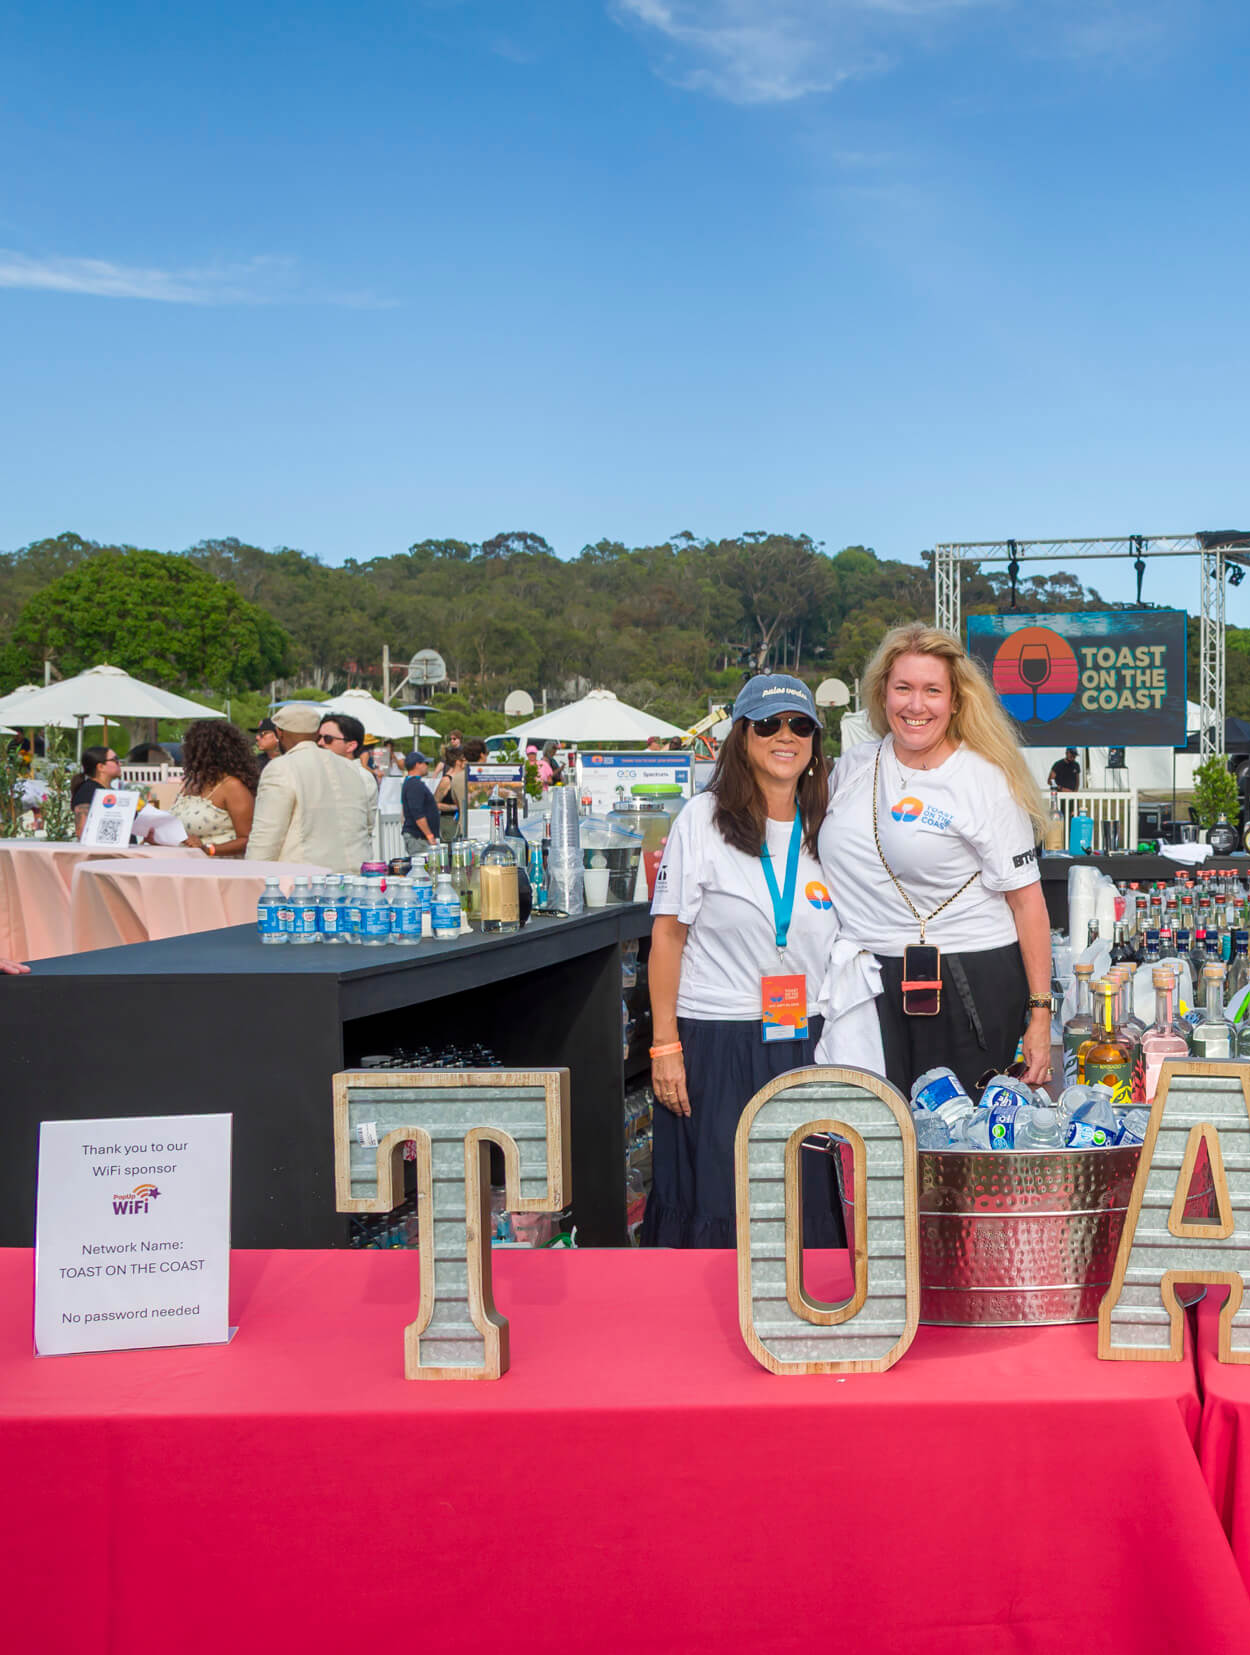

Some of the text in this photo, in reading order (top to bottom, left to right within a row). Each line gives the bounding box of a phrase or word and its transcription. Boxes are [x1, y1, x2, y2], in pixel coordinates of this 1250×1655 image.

[1080, 645, 1167, 668] TOAST
[1081, 668, 1166, 689] ON THE
[1081, 689, 1167, 710] COAST
[82, 1141, 188, 1156] Thank you to our
[92, 1163, 177, 1177] WiFi sponsor
[112, 1197, 149, 1216] WiFi
[82, 1240, 184, 1256] Network Name:
[59, 1258, 206, 1279] TOAST ON THE COAST
[62, 1304, 200, 1325] No password needed
